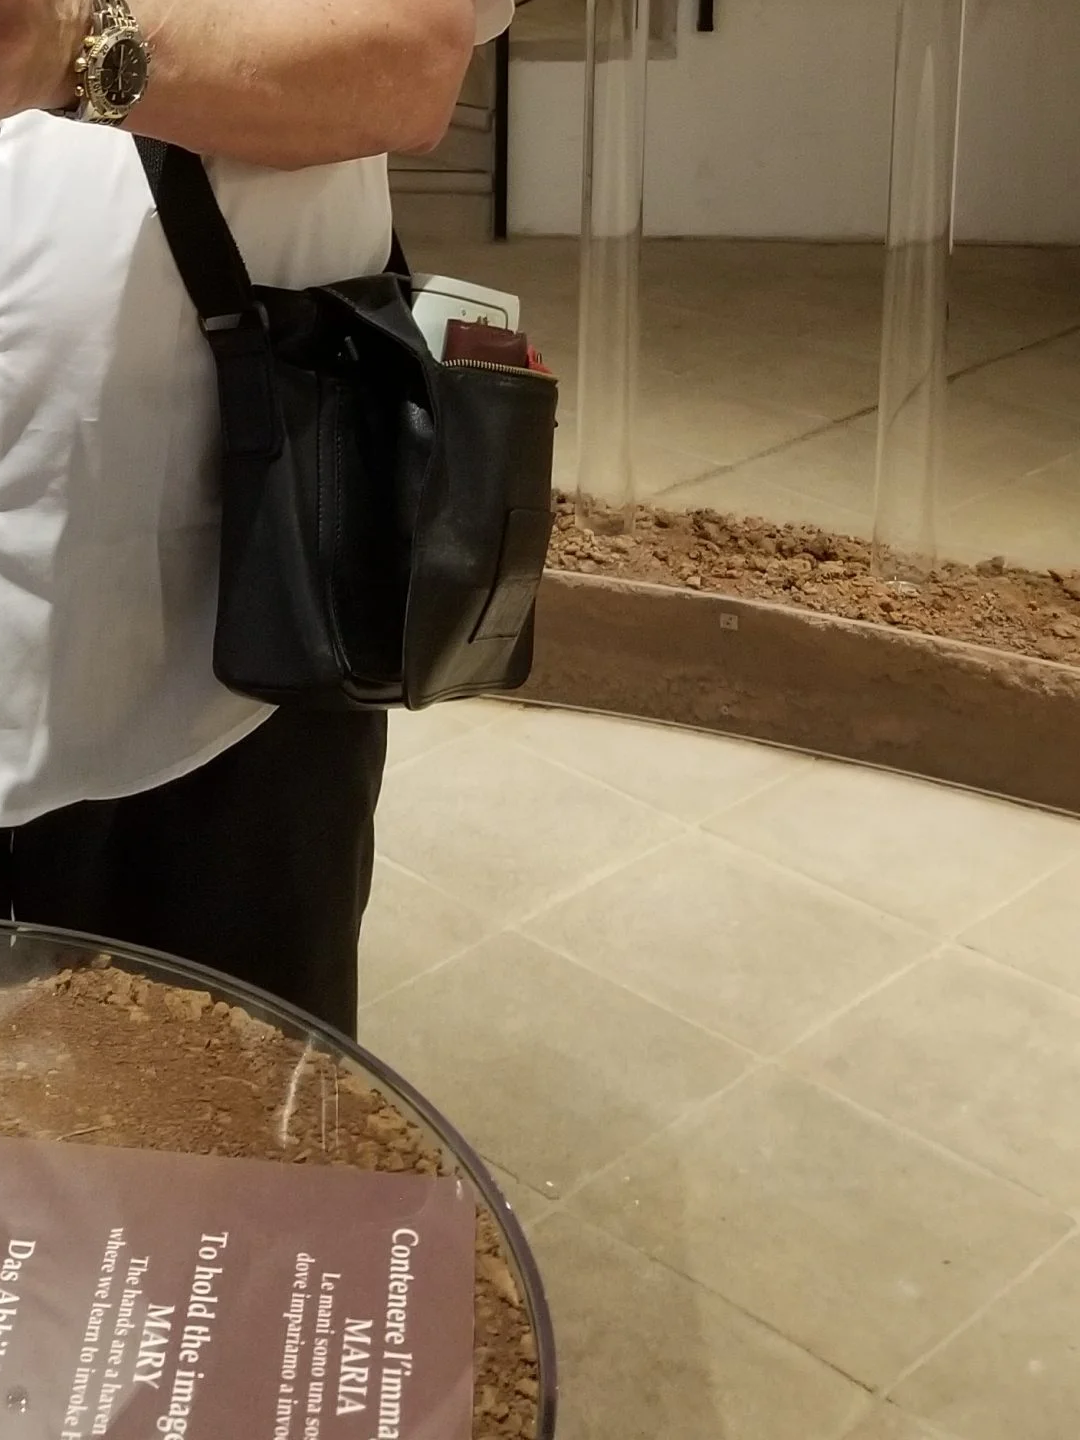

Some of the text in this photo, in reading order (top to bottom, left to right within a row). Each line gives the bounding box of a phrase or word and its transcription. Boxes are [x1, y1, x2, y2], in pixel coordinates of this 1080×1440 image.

[0, 1239, 37, 1282] Das
[101, 1228, 126, 1273] where
[198, 1232, 229, 1260] To
[95, 1277, 112, 1299] we
[293, 1252, 316, 1290] dove
[321, 1272, 341, 1291] Le
[187, 1265, 223, 1319] hold
[84, 1303, 112, 1342] learn
[316, 1294, 335, 1334] mani
[377, 1228, 419, 1439] Contenere l'imma
[80, 1346, 99, 1363] to
[92, 1256, 149, 1435] The hands are a haven
[133, 1303, 176, 1389] MARY
[179, 1325, 211, 1363] the
[281, 1292, 312, 1380] impariamo
[311, 1338, 328, 1378] sono
[336, 1317, 373, 1416] MARIA
[64, 1367, 96, 1426] invoke
[279, 1383, 294, 1394] a
[307, 1381, 325, 1413] una
